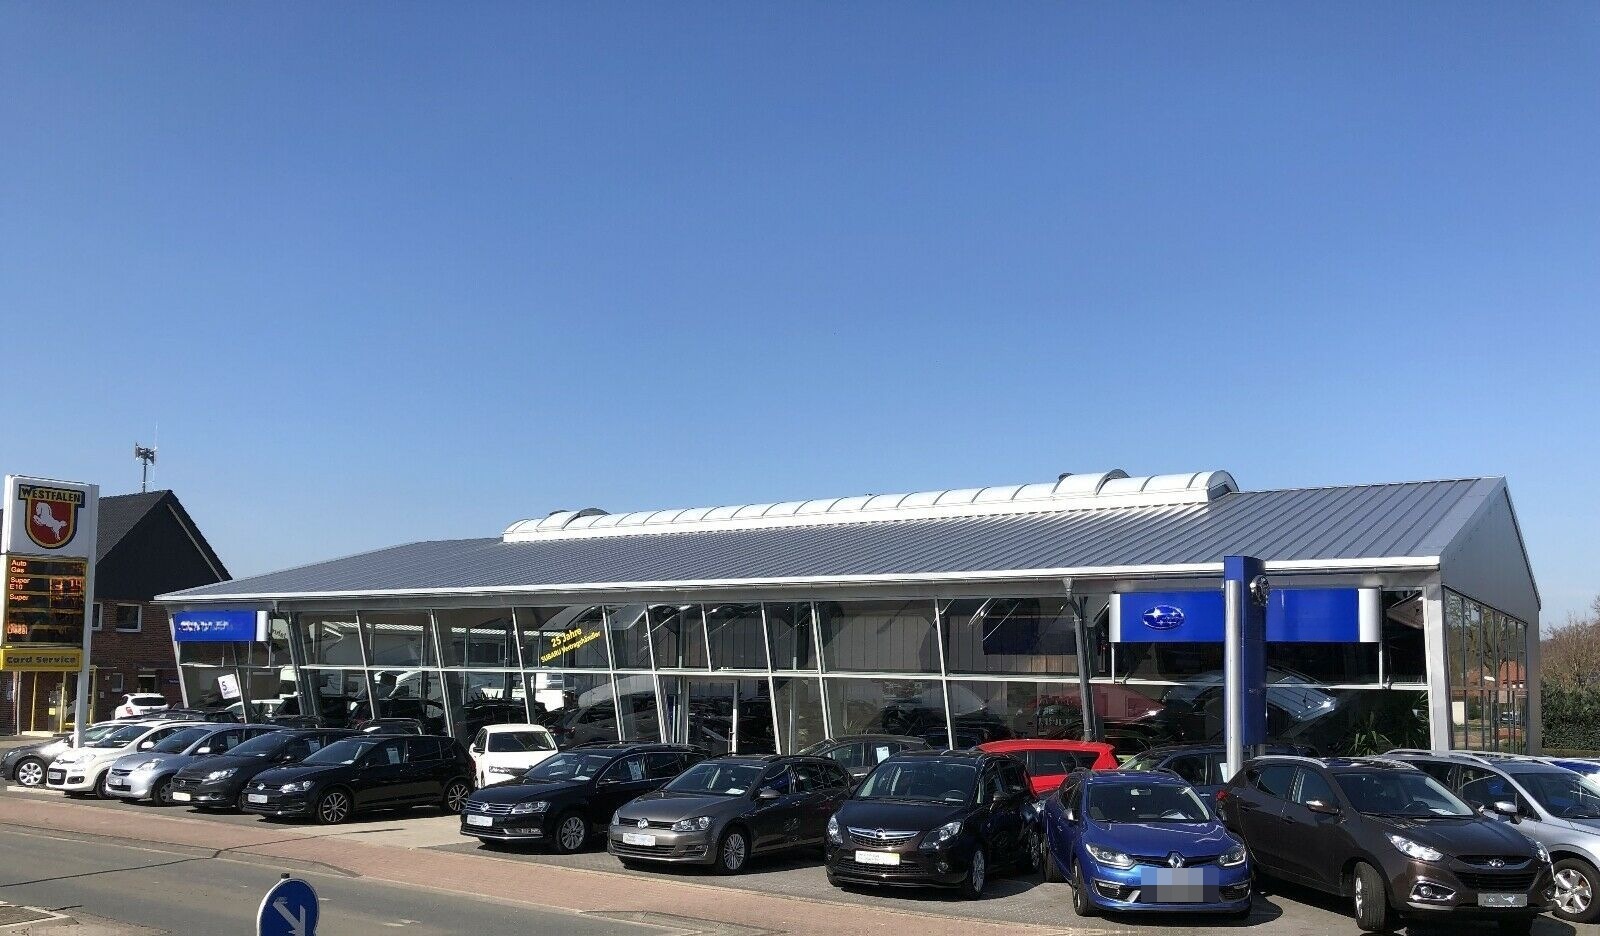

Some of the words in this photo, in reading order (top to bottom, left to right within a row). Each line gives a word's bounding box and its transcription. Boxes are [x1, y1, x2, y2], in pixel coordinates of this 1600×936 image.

[21, 487, 81, 503] WESTFALEN
[11, 559, 27, 567] Auto
[10, 576, 31, 585] Super
[551, 636, 561, 647] 25
[563, 628, 582, 642] Jahre
[6, 656, 33, 664] Card
[36, 656, 77, 664] Service
[541, 649, 561, 662] SUBARU
